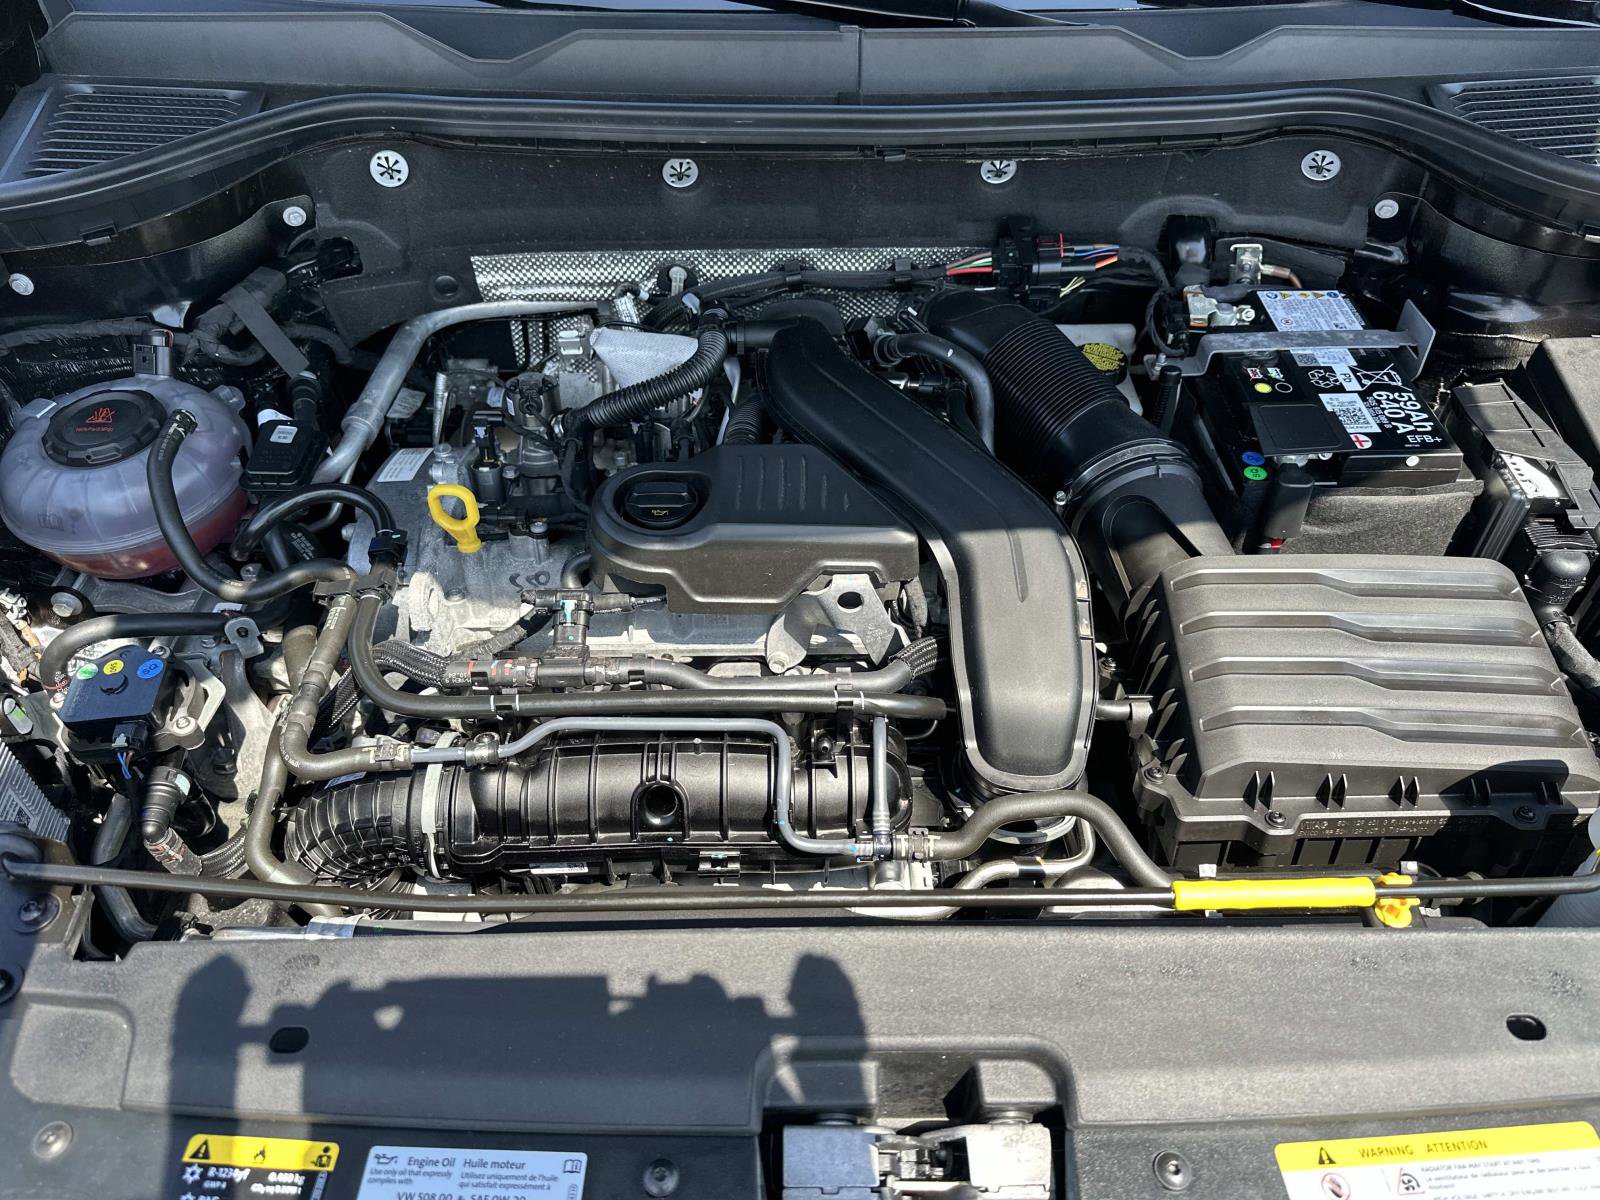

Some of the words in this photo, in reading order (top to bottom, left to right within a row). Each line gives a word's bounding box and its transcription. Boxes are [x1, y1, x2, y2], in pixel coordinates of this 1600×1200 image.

[1340, 372, 1352, 383] Pb
[1372, 391, 1405, 418] 640
[1391, 421, 1415, 434] A
[1393, 391, 1434, 432] 59Ah
[1406, 434, 1443, 444] EFB+
[1358, 1144, 1414, 1158] WARNING
[1426, 1139, 1488, 1154] ATTENTION
[407, 1156, 440, 1169] Engine
[441, 1157, 456, 1167] Oil
[463, 1158, 489, 1169] Huile
[490, 1160, 526, 1170] moteur
[383, 1168, 397, 1177] only
[398, 1168, 407, 1176] oil
[422, 1170, 453, 1179] expressly
[460, 1171, 485, 1180] Utilisez
[486, 1173, 527, 1183] uniquement
[538, 1173, 559, 1182] l'huile
[367, 1177, 397, 1186] complies
[398, 1177, 413, 1185] with
[459, 1181, 469, 1189] qui
[471, 1181, 498, 1189] satisfait
[498, 1182, 543, 1192] expressément
[545, 1183, 551, 1191] à
[397, 1191, 416, 1200] VW
[417, 1192, 438, 1200] 508
